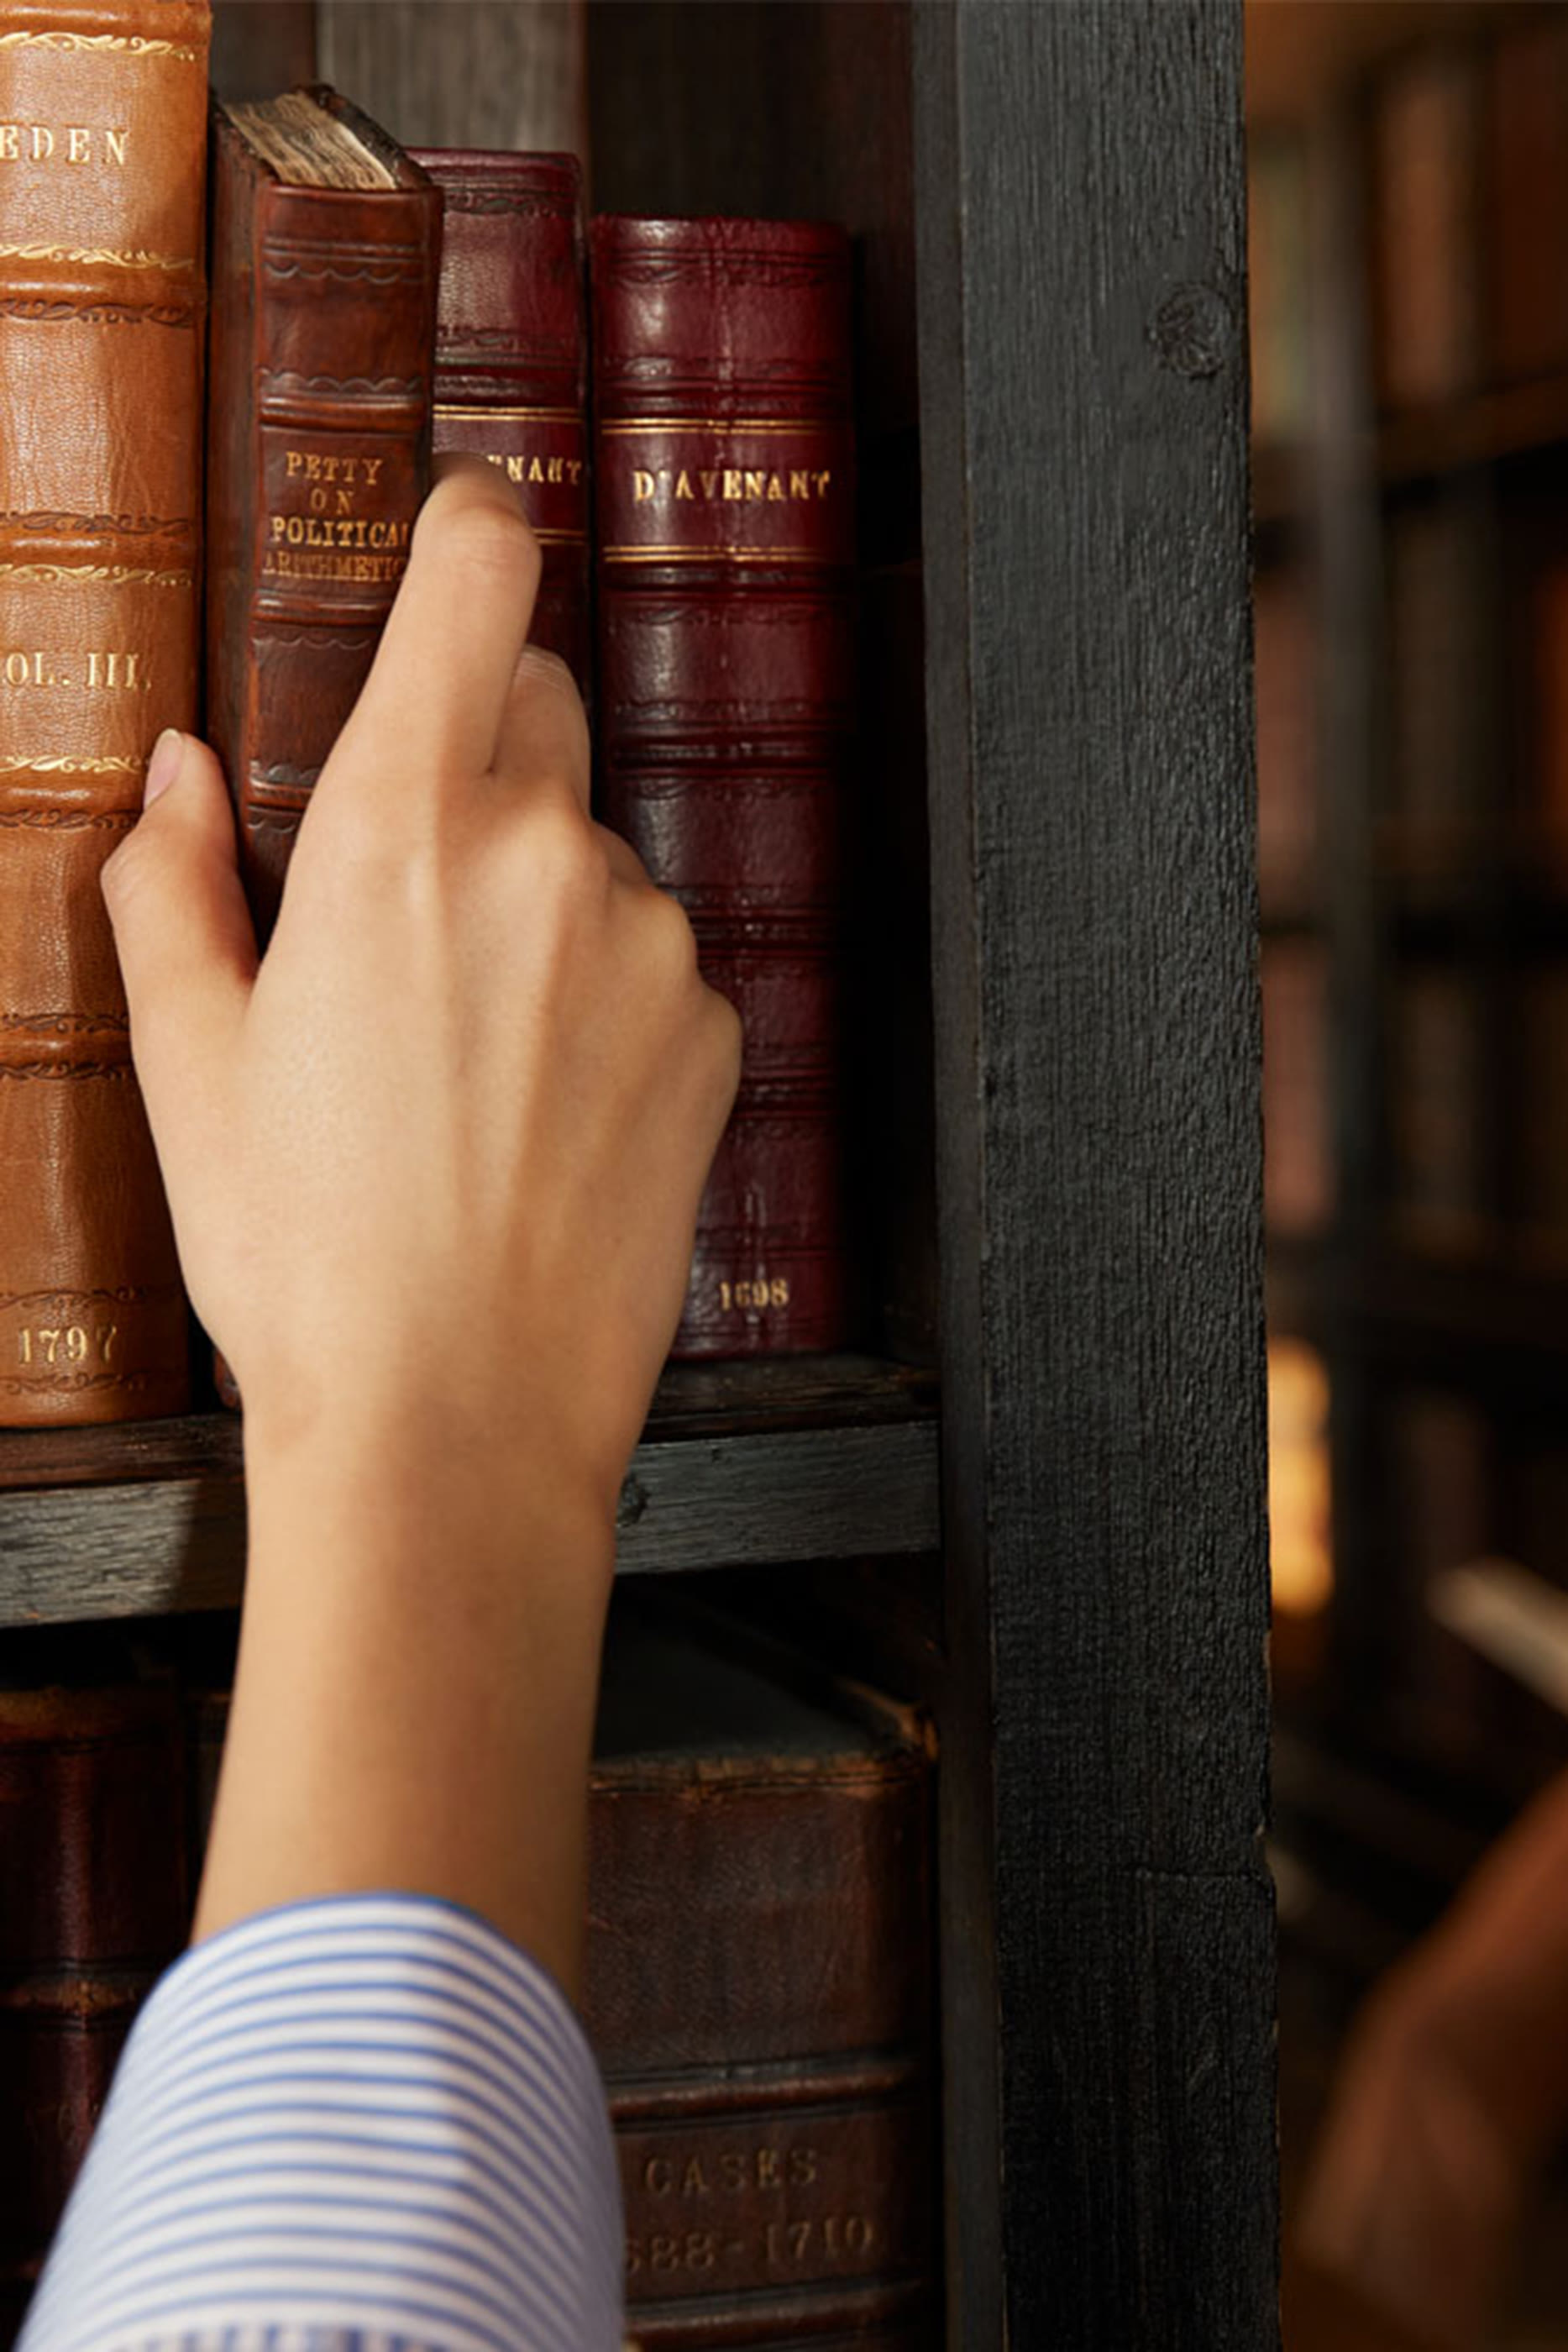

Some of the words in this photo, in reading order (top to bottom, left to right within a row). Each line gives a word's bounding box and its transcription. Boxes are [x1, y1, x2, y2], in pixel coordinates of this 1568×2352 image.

[0, 125, 129, 165] EDEN
[286, 452, 382, 485] PETTY
[311, 488, 354, 515] ON
[22, 1326, 117, 1363] 1797
[645, 2149, 817, 2198] CASES
